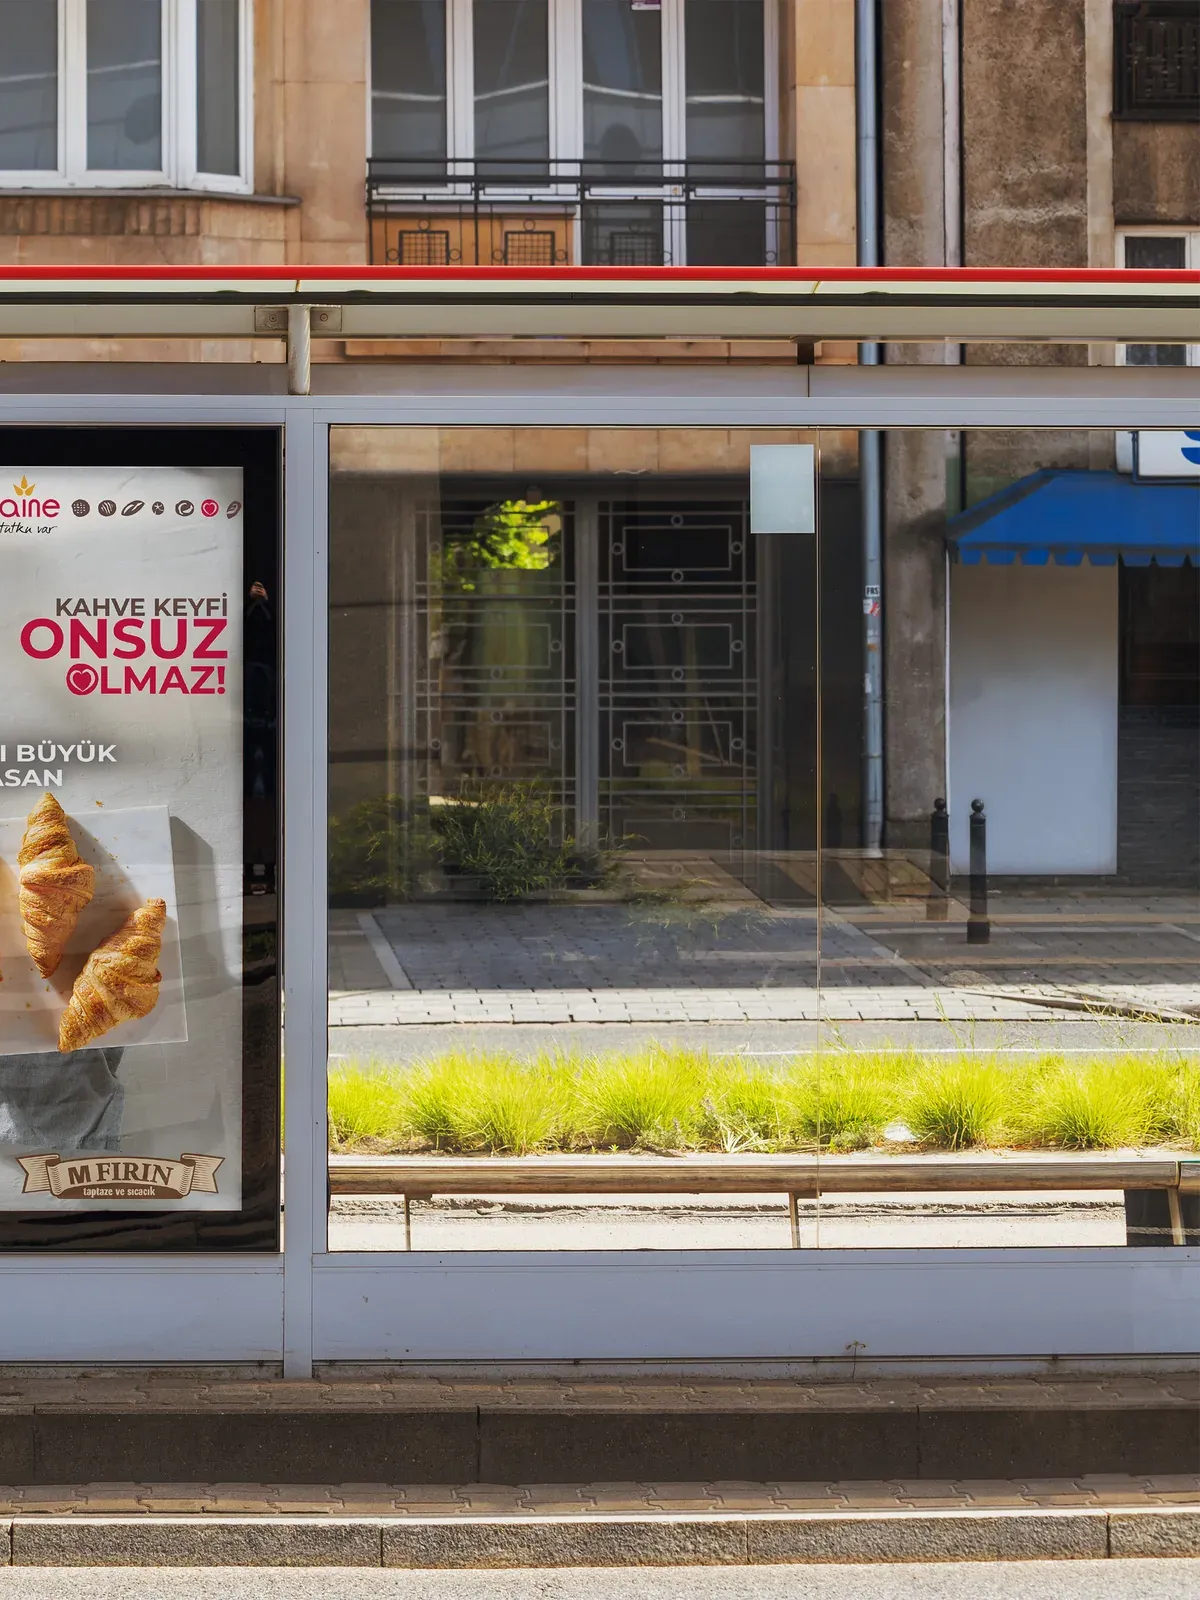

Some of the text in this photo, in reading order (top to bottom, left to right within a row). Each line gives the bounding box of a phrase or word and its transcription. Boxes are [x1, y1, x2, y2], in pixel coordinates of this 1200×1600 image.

[0, 521, 33, 534] tutku
[37, 525, 57, 534] var
[56, 592, 228, 617] KAHVE KEYFİ
[20, 618, 228, 659] ONSUZ
[17, 740, 117, 762] BÜYÜK
[67, 1162, 174, 1185] M FIRIN
[83, 1187, 113, 1198] taptaze
[115, 1188, 125, 1196] ve
